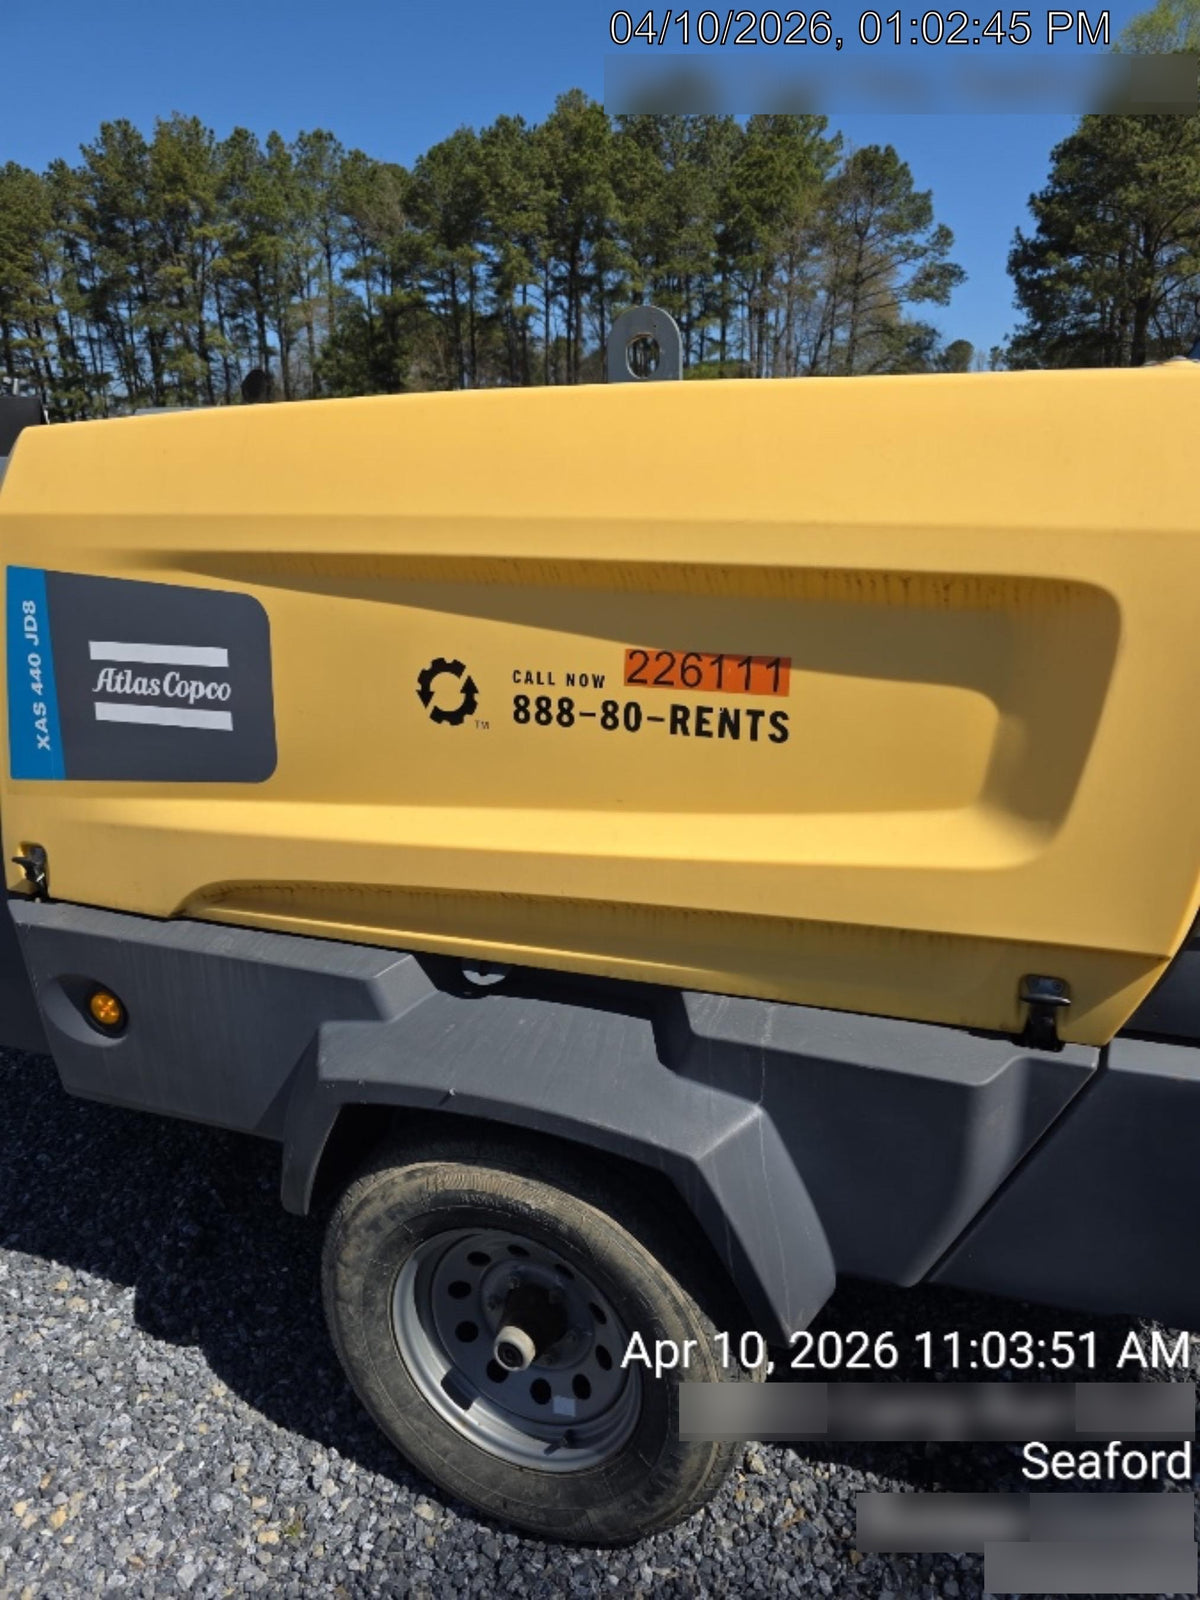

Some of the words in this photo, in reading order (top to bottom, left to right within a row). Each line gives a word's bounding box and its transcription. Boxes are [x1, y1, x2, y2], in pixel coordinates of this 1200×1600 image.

[22, 600, 39, 646] JD8
[28, 653, 43, 695] 440
[92, 667, 160, 696] Atlas
[163, 671, 232, 704] Copco
[512, 669, 556, 686] CALL
[566, 673, 606, 689] NOW
[626, 650, 783, 693] 226111
[33, 703, 50, 750] XAS
[512, 694, 790, 743] 888-80-RENTS
